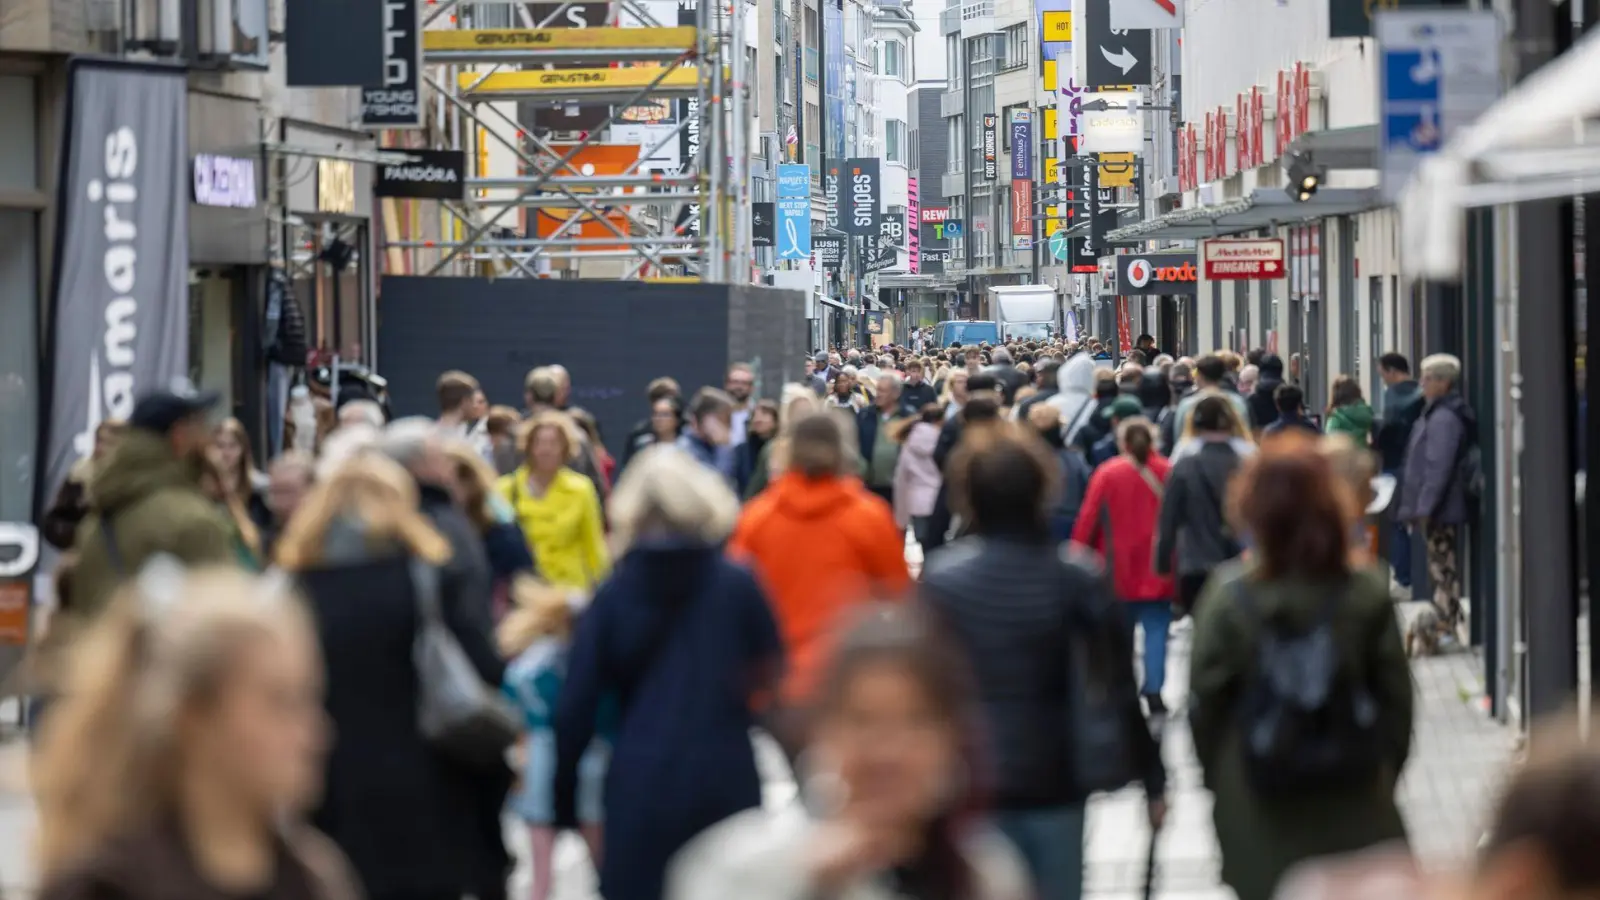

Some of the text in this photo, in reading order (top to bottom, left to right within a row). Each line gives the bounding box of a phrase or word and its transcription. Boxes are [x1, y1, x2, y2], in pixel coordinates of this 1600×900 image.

[365, 89, 415, 103] YOUNG
[687, 96, 700, 159] RAINERS
[1014, 124, 1027, 177] Eenthaus 73
[384, 165, 457, 182] PANDORA
[985, 162, 995, 178] FOOT
[853, 174, 876, 227] snipes
[814, 240, 839, 248] LUSH
[1212, 261, 1260, 274] EINGANG
